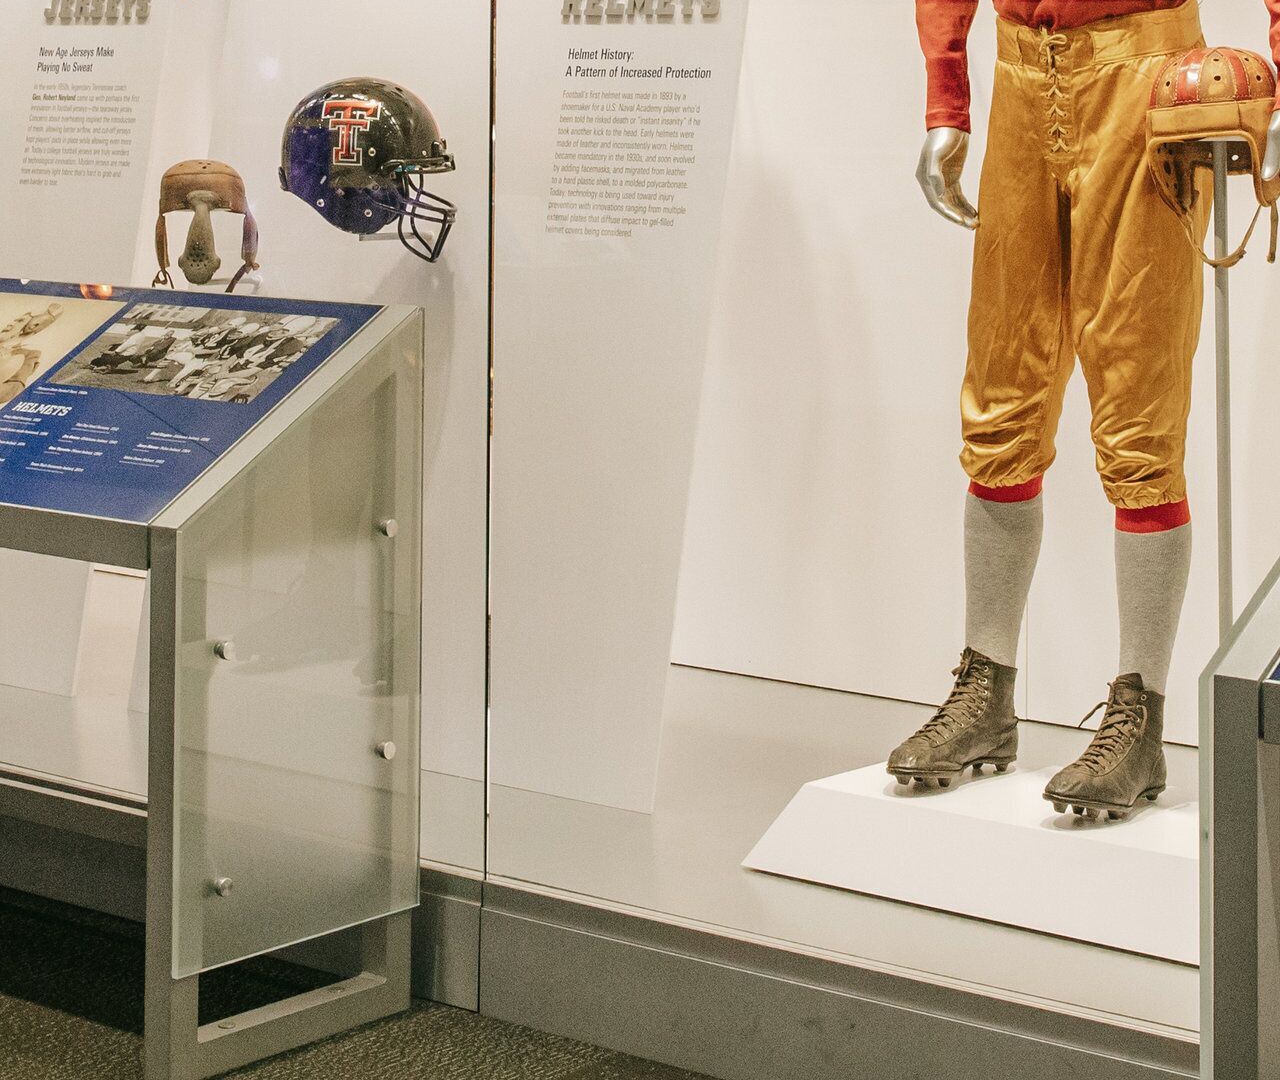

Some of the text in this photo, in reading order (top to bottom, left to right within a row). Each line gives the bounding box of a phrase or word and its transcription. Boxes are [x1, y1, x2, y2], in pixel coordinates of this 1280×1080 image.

[40, 47, 114, 58] New Age Jerseys Make
[569, 49, 634, 62] Helmet History:
[38, 62, 93, 73] Playing No Sweat
[566, 65, 712, 77] A Pattern of Increased Protection
[12, 402, 72, 416] HELMETS
